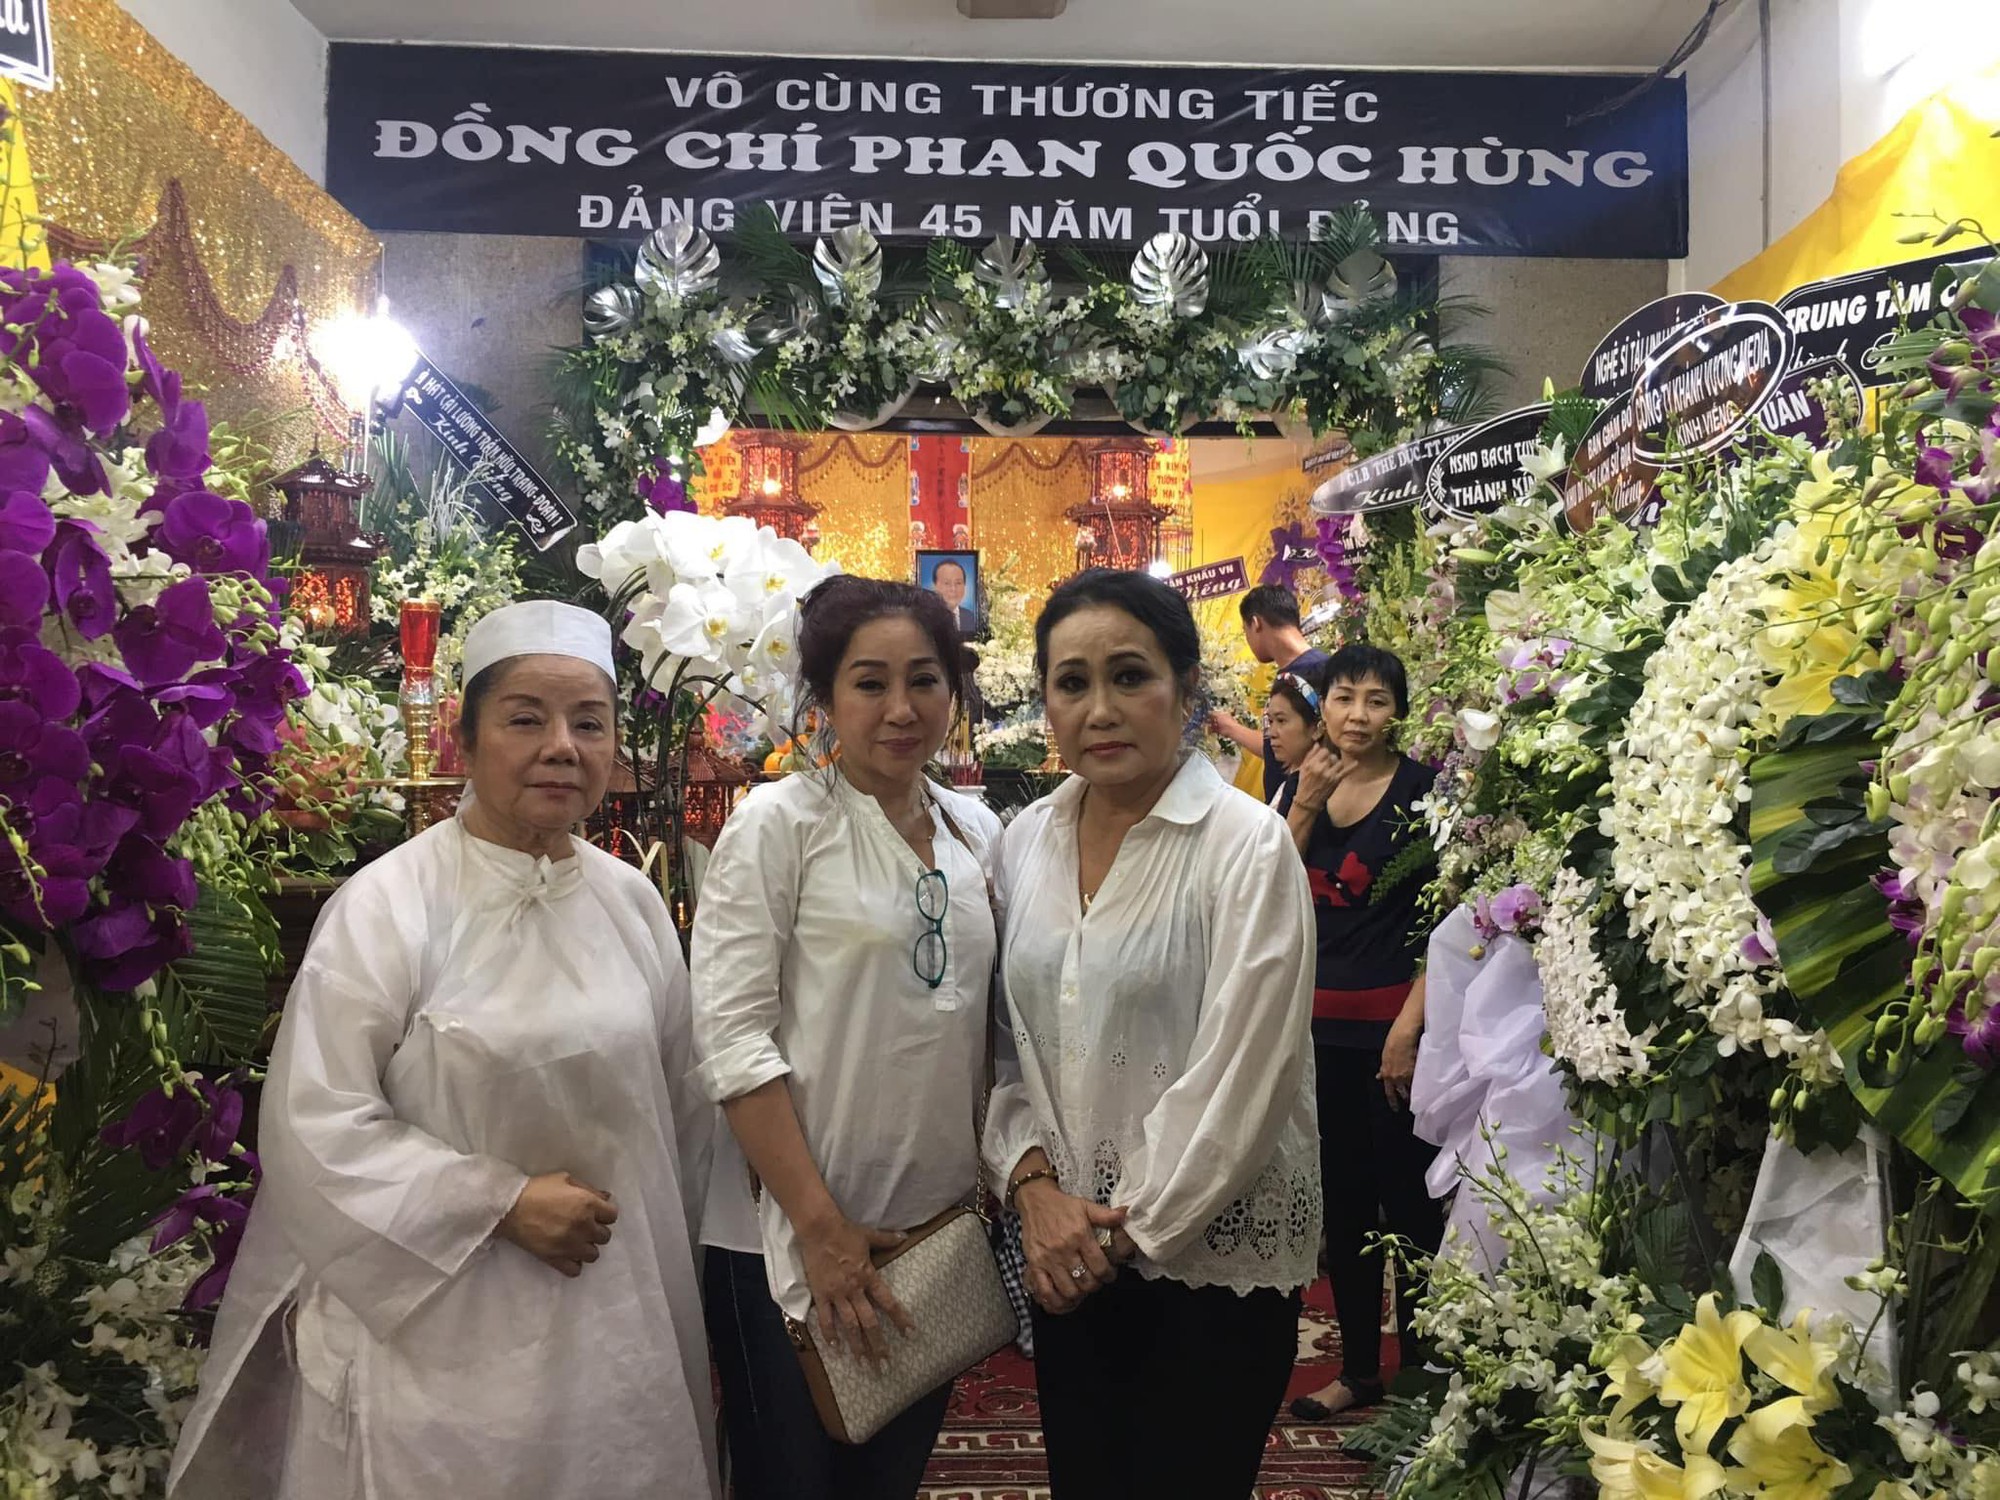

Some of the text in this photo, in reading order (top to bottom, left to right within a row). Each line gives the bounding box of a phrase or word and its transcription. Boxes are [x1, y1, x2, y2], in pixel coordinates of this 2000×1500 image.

[665, 71, 1379, 123] VÔ CÙNG THƯƠNG TIẾC
[373, 102, 1654, 189] ĐỒNG CHÍ PHAN QUỐC HÙNG
[577, 184, 1459, 245] ĐẢNG VIÊN 45 NĂM TUỔI ĐNG
[1785, 294, 1868, 335] TRUNG
[1875, 281, 1931, 320] TÂM
[1634, 383, 1663, 432] CÔNG
[1672, 360, 1705, 414] KHÁNH
[1758, 387, 1812, 431] UÂN
[450, 406, 482, 438] LƯƠNG
[1676, 417, 1702, 446] KÍNH
[1701, 401, 1737, 435] VIẾNG
[1449, 450, 1479, 474] NSND
[1480, 444, 1513, 469] BẠCH
[1451, 479, 1507, 508] THÀNH
[1185, 568, 1216, 584] KHẤU
[1218, 564, 1234, 576] VN
